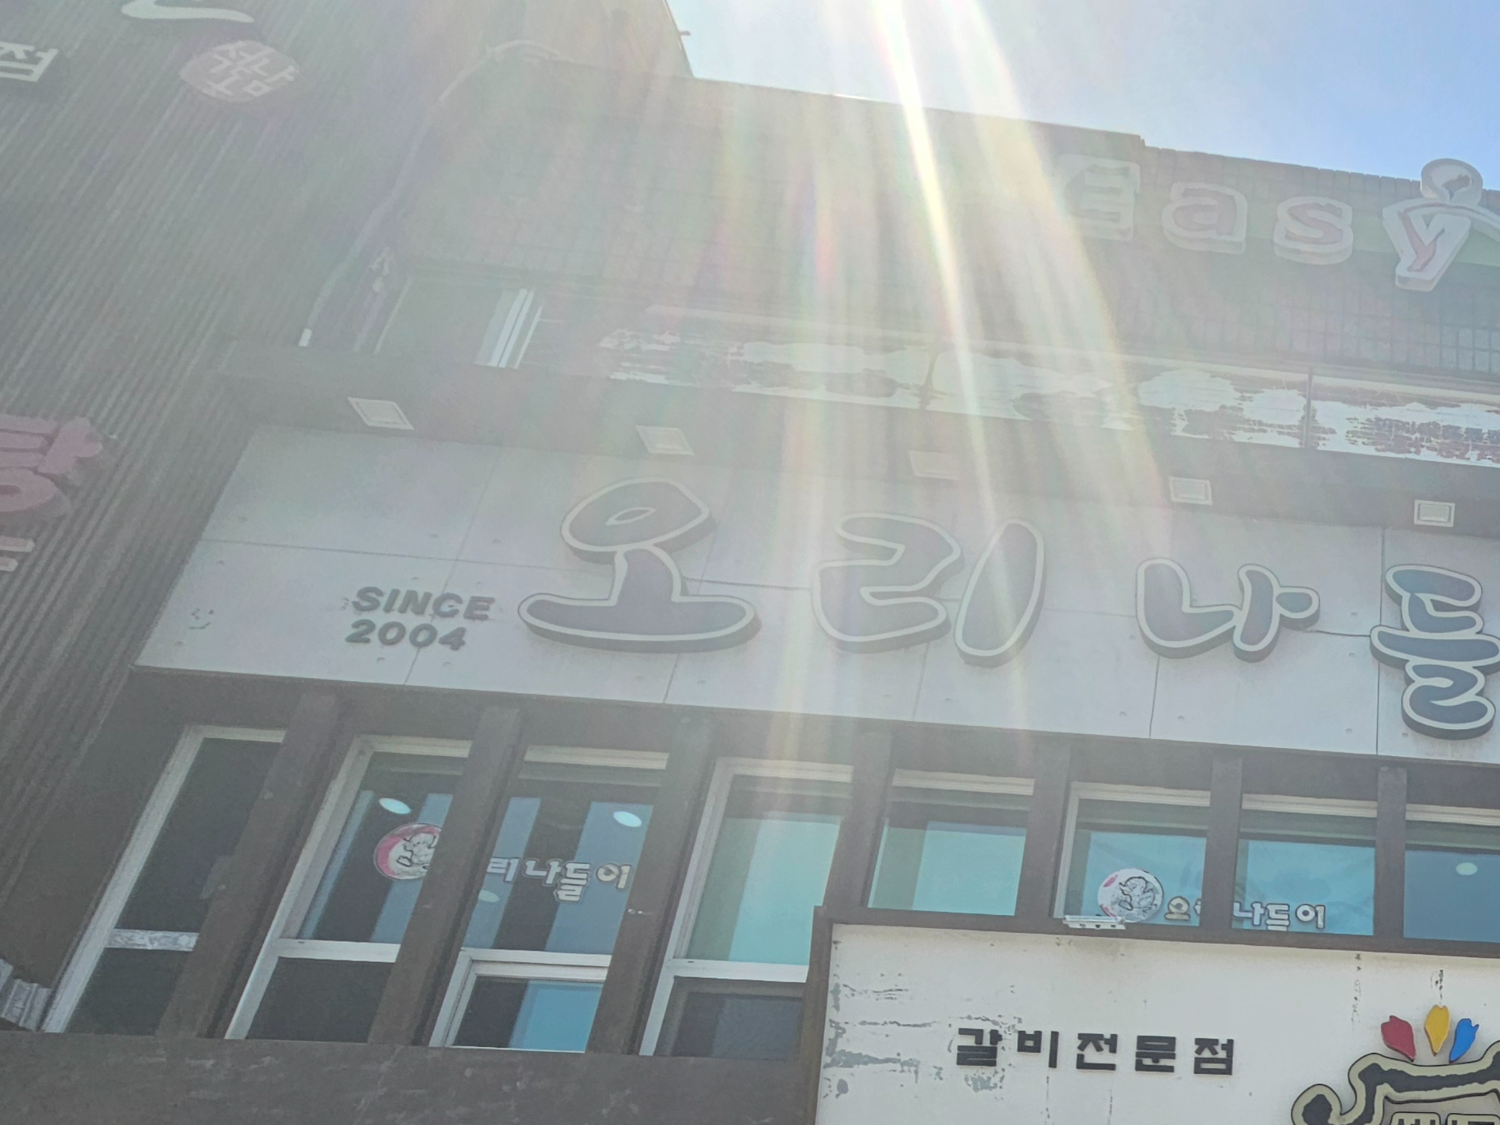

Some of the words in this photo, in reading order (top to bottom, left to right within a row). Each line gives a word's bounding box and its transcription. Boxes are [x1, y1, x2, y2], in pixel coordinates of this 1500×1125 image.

[351, 586, 496, 621] SINCE
[344, 618, 467, 651] 2004
[487, 856, 634, 903] 리나들이
[956, 1027, 1235, 1076] 갈비전문점
